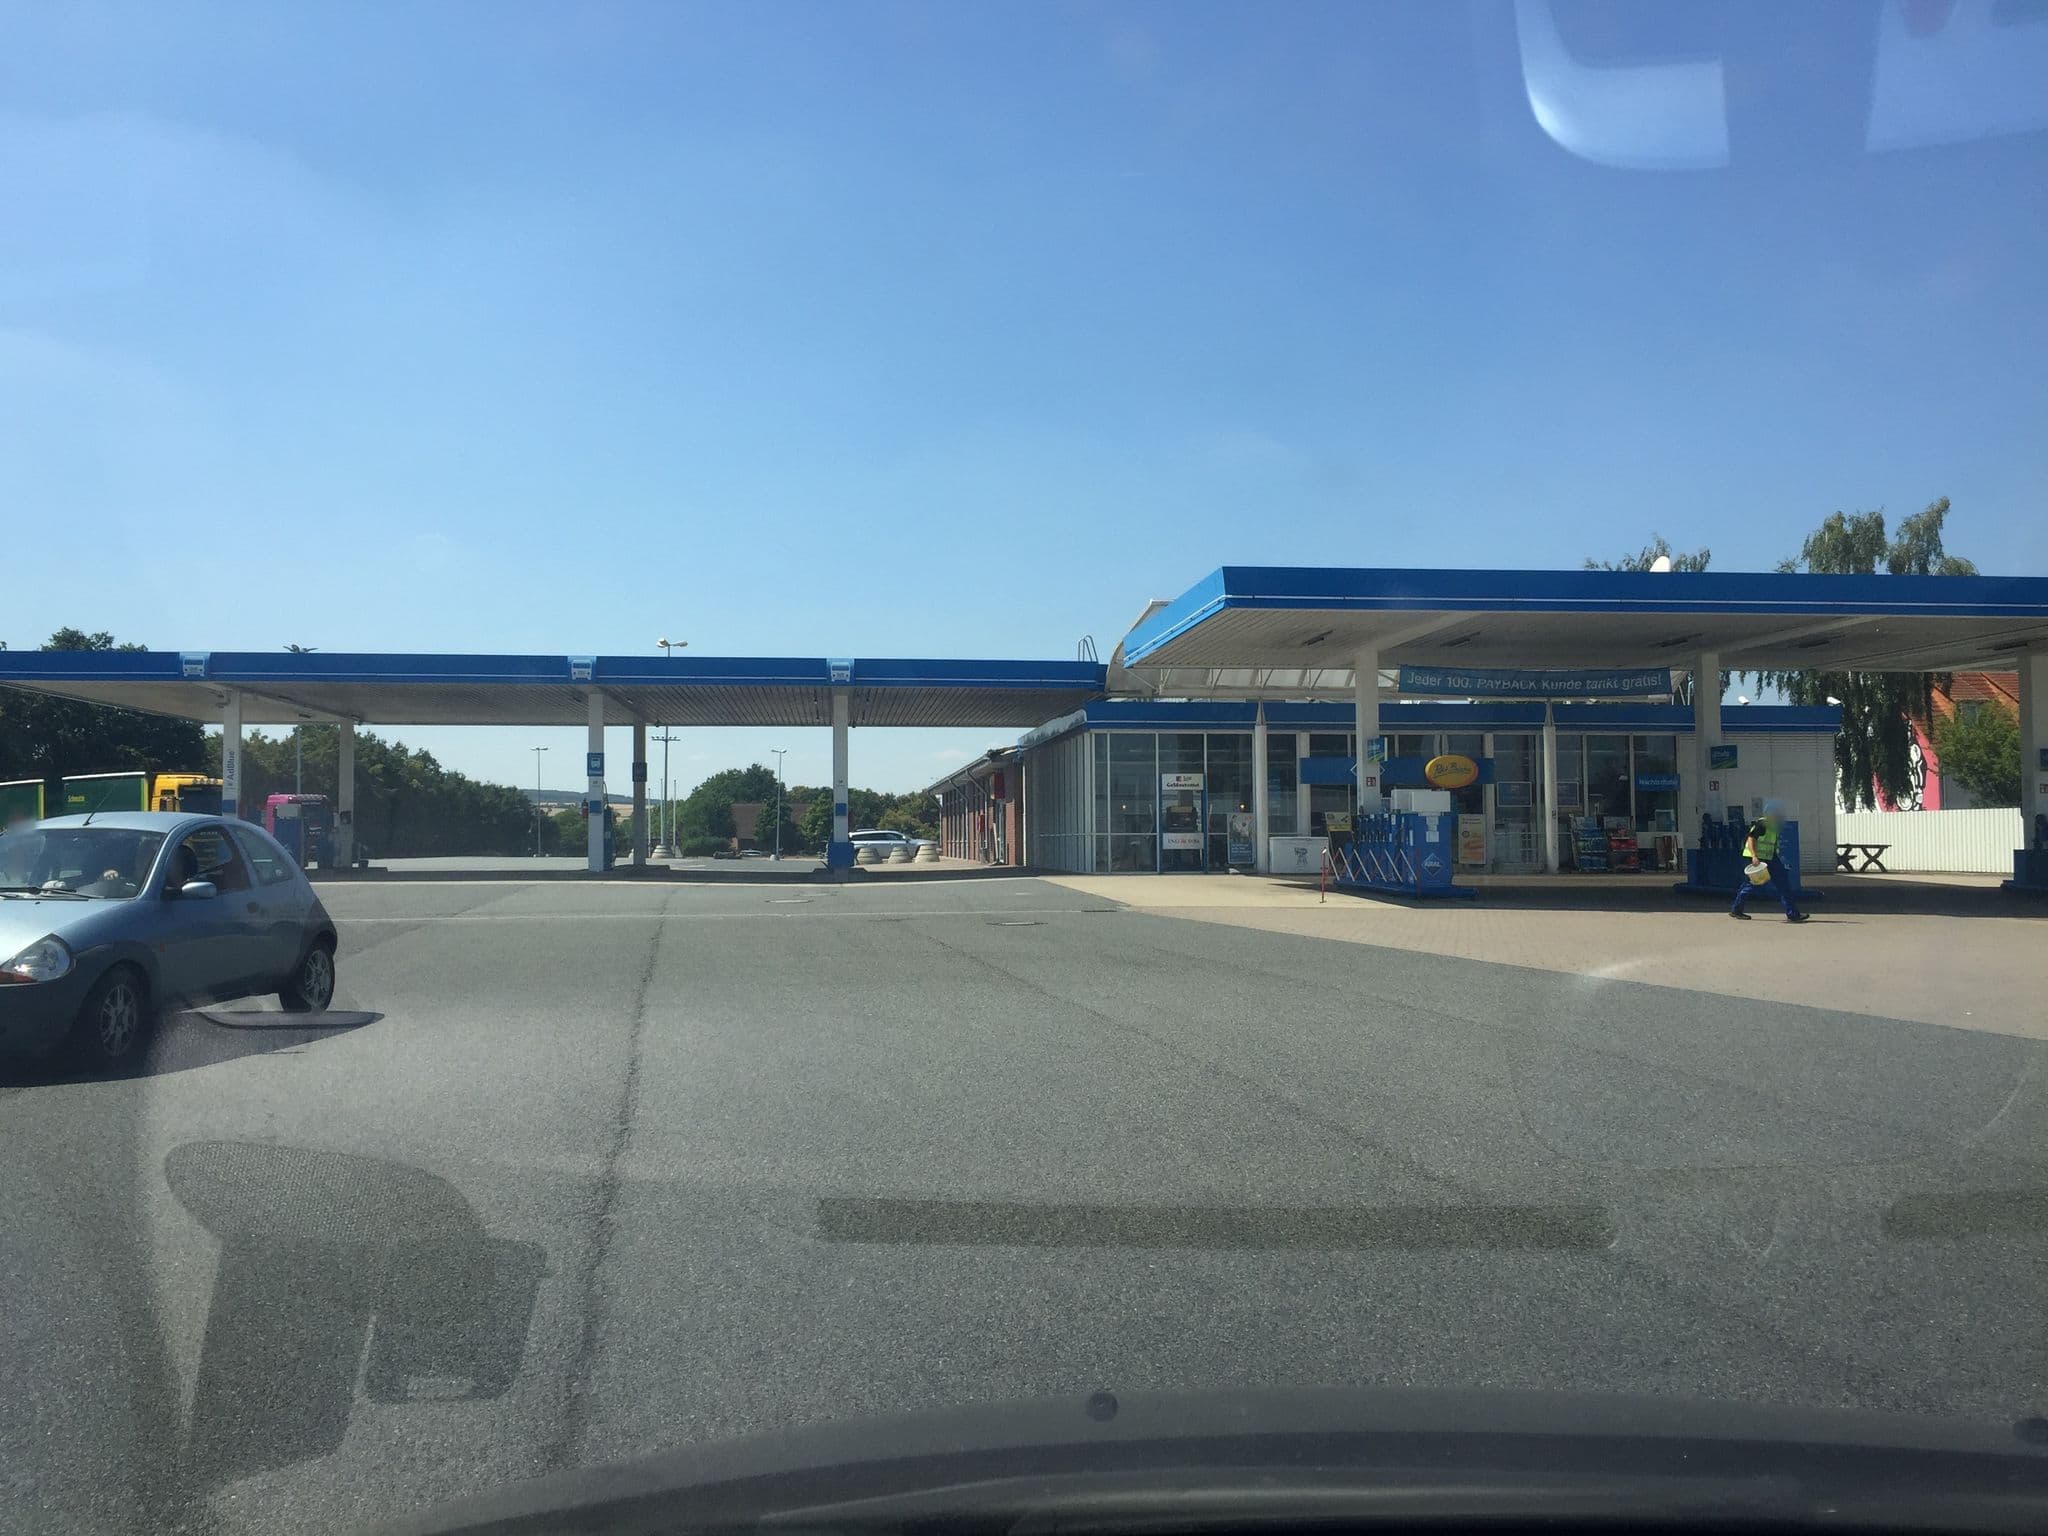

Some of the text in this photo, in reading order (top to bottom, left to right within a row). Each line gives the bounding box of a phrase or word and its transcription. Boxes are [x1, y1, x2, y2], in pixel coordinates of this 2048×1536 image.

[1407, 671, 1662, 690] Jeder 100. PAYBACK Kunde tankt gratis!
